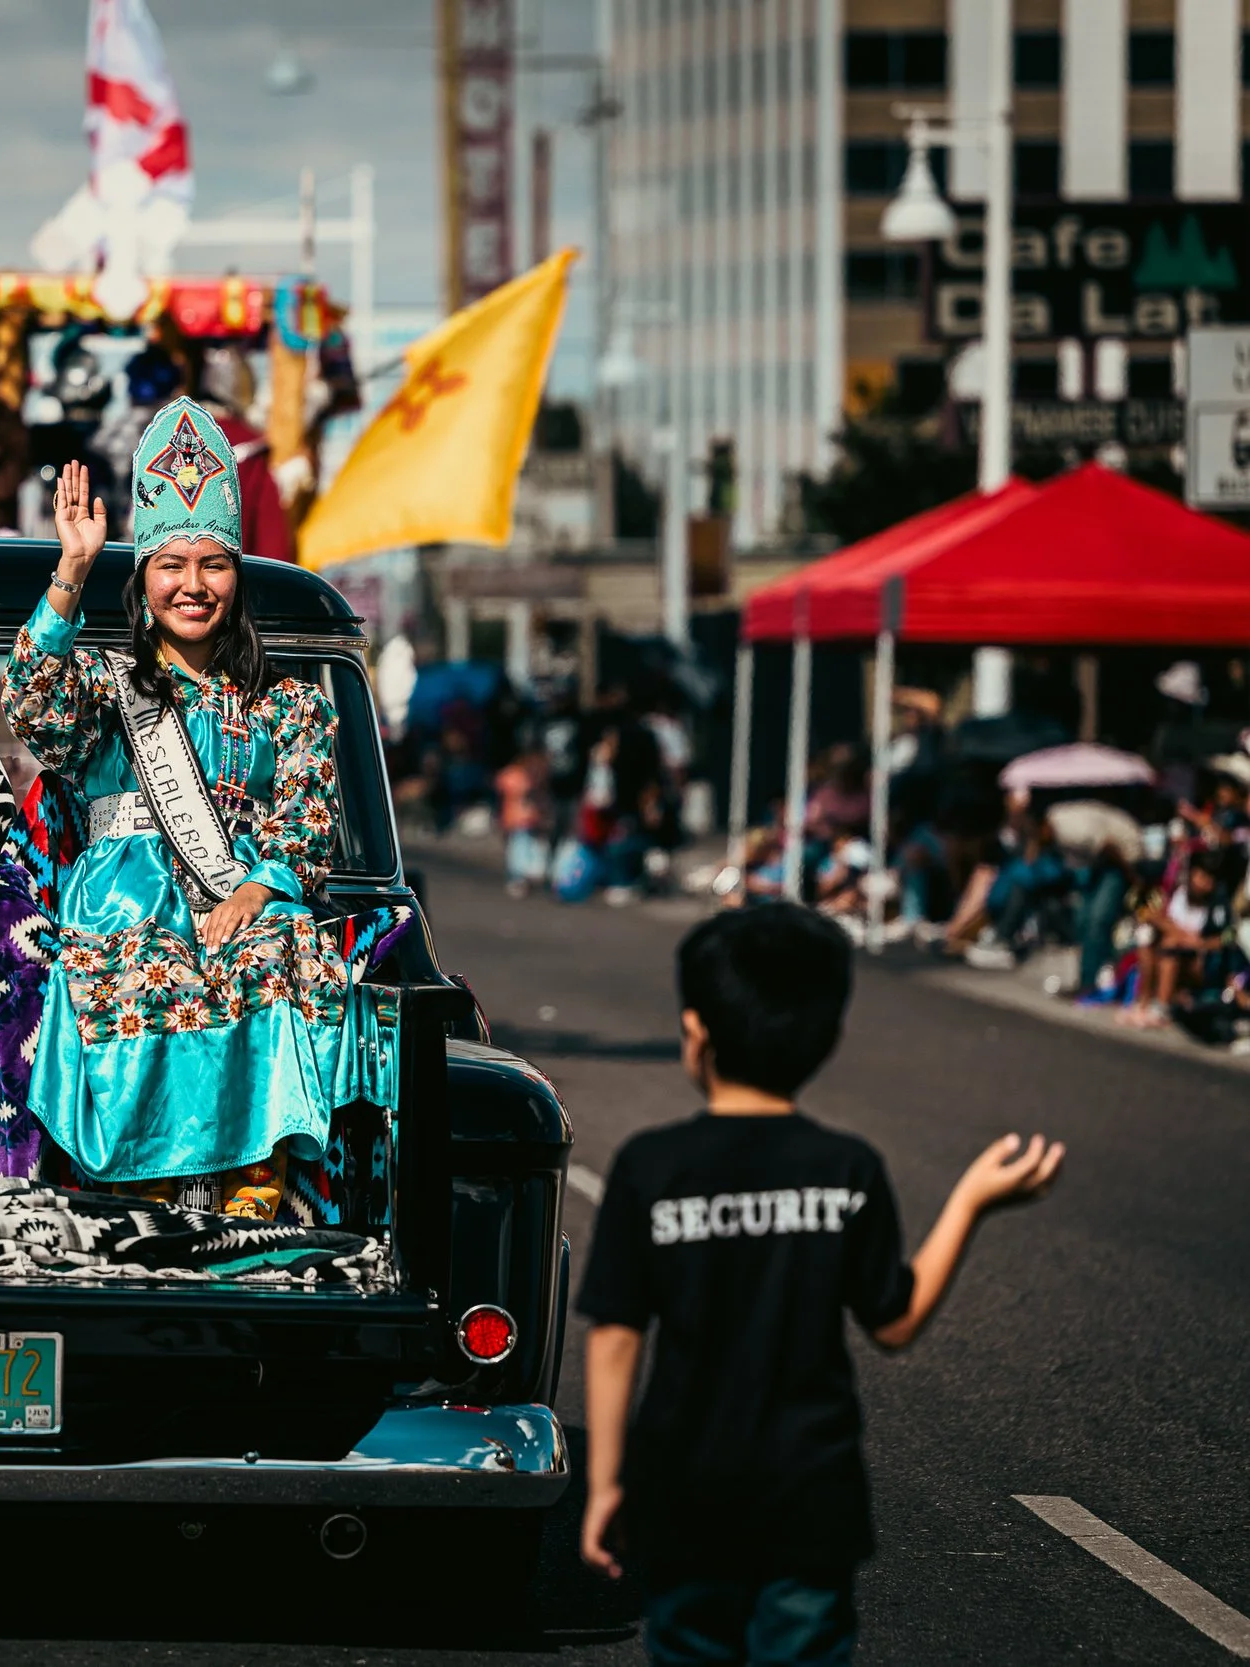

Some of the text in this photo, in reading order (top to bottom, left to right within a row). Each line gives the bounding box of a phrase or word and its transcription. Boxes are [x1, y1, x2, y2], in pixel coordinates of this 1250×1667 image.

[944, 217, 1130, 269] Cafe
[938, 281, 1218, 336] Da Lat
[152, 517, 201, 536] Mescalero
